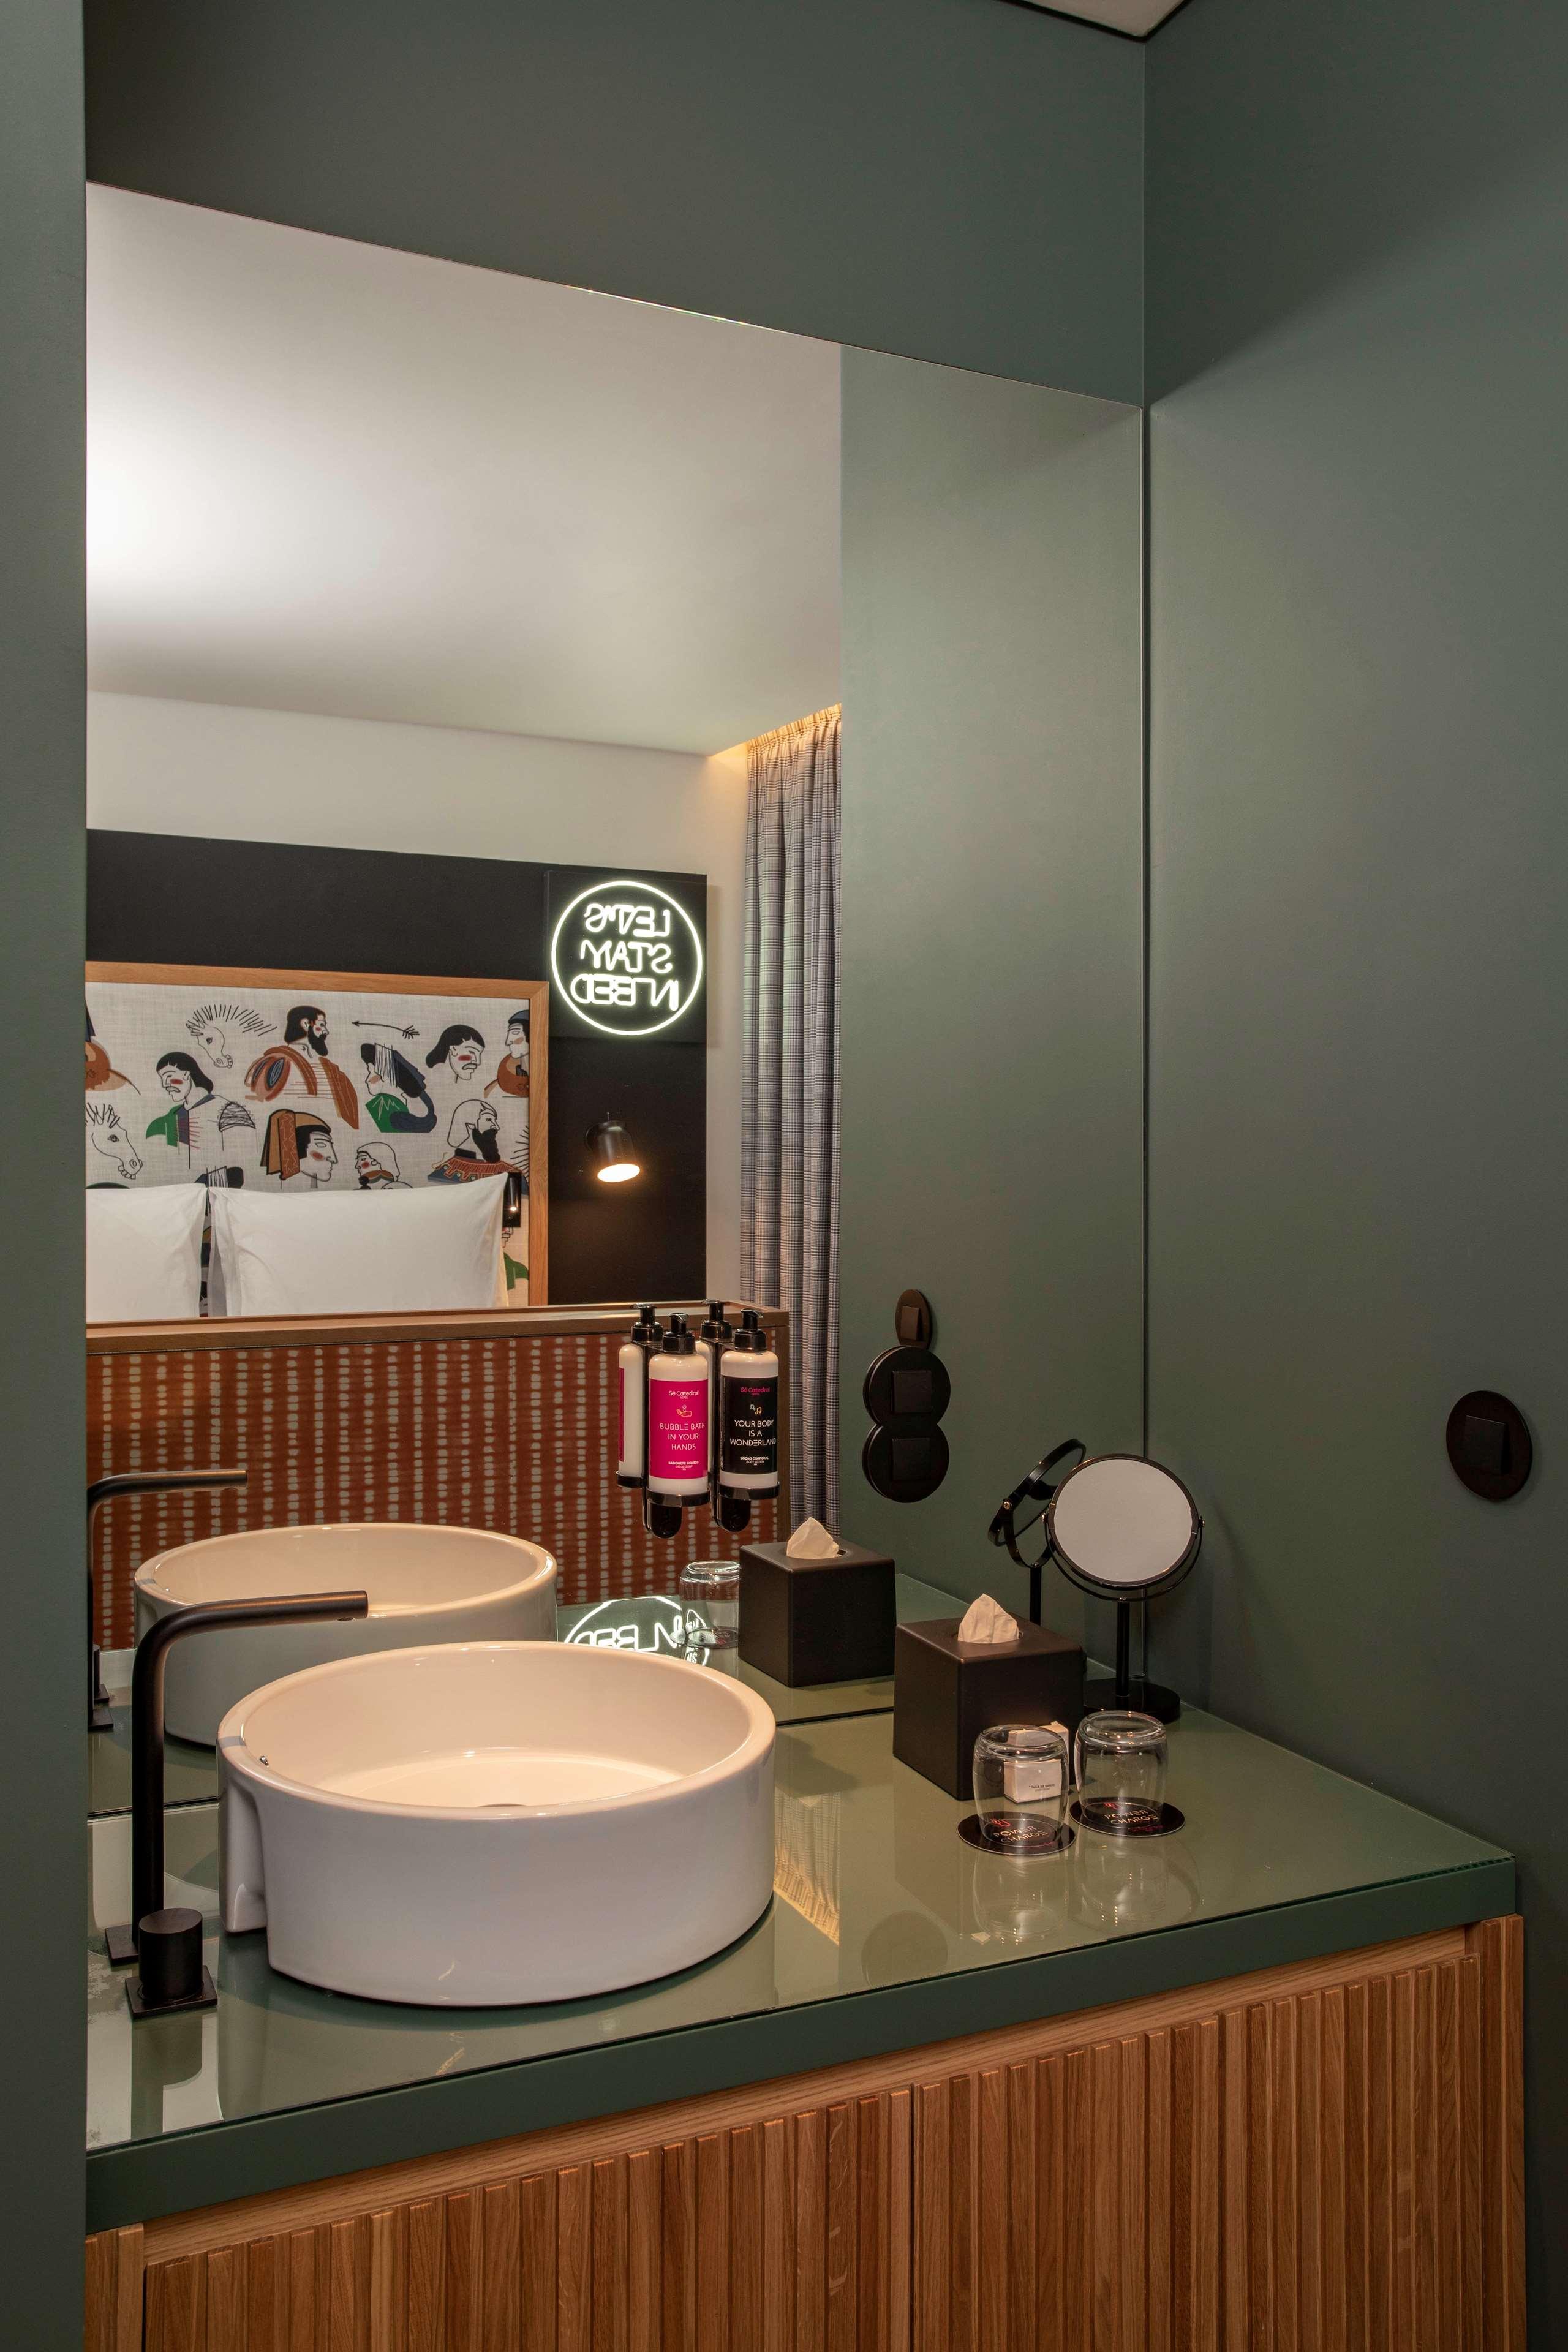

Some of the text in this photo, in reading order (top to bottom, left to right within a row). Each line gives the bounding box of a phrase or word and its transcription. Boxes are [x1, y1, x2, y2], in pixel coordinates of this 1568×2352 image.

[729, 1438, 777, 1446] WONDERLAND
[1104, 1809, 1148, 1819] POWER
[1110, 1814, 1158, 1825] CHARGE
[993, 1825, 1037, 1838] POWER
[1000, 1830, 1049, 1843] CHARGE
